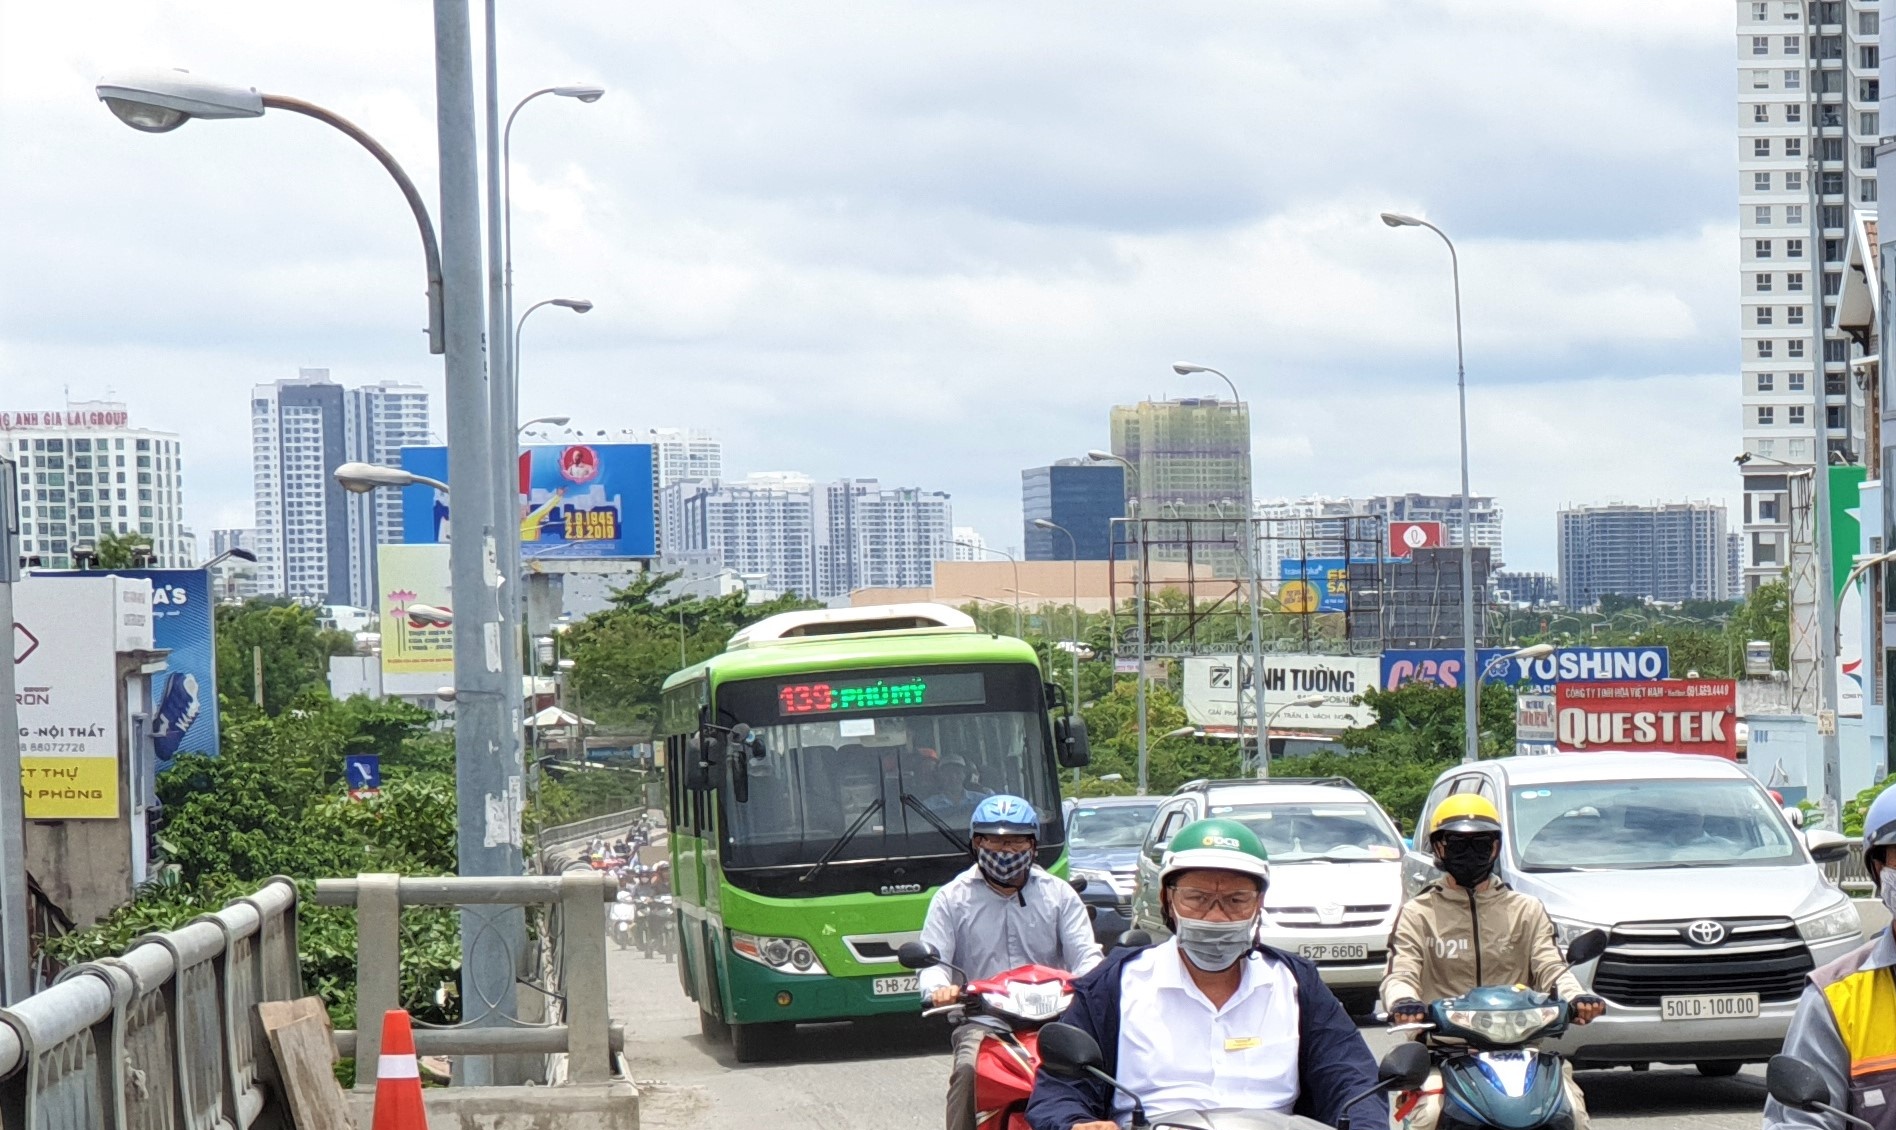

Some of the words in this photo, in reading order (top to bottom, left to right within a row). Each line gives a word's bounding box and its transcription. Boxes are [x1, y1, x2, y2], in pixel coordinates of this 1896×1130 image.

[16, 412, 39, 426] ANH
[43, 412, 62, 426] GIA
[67, 411, 86, 426] LAI
[89, 411, 127, 426] GROUP
[1516, 651, 1662, 681] YOSHINO
[1559, 708, 1726, 749] QUESTEK
[39, 787, 103, 799] PHÒNG
[1667, 997, 1754, 1017] 50LD-100.00
